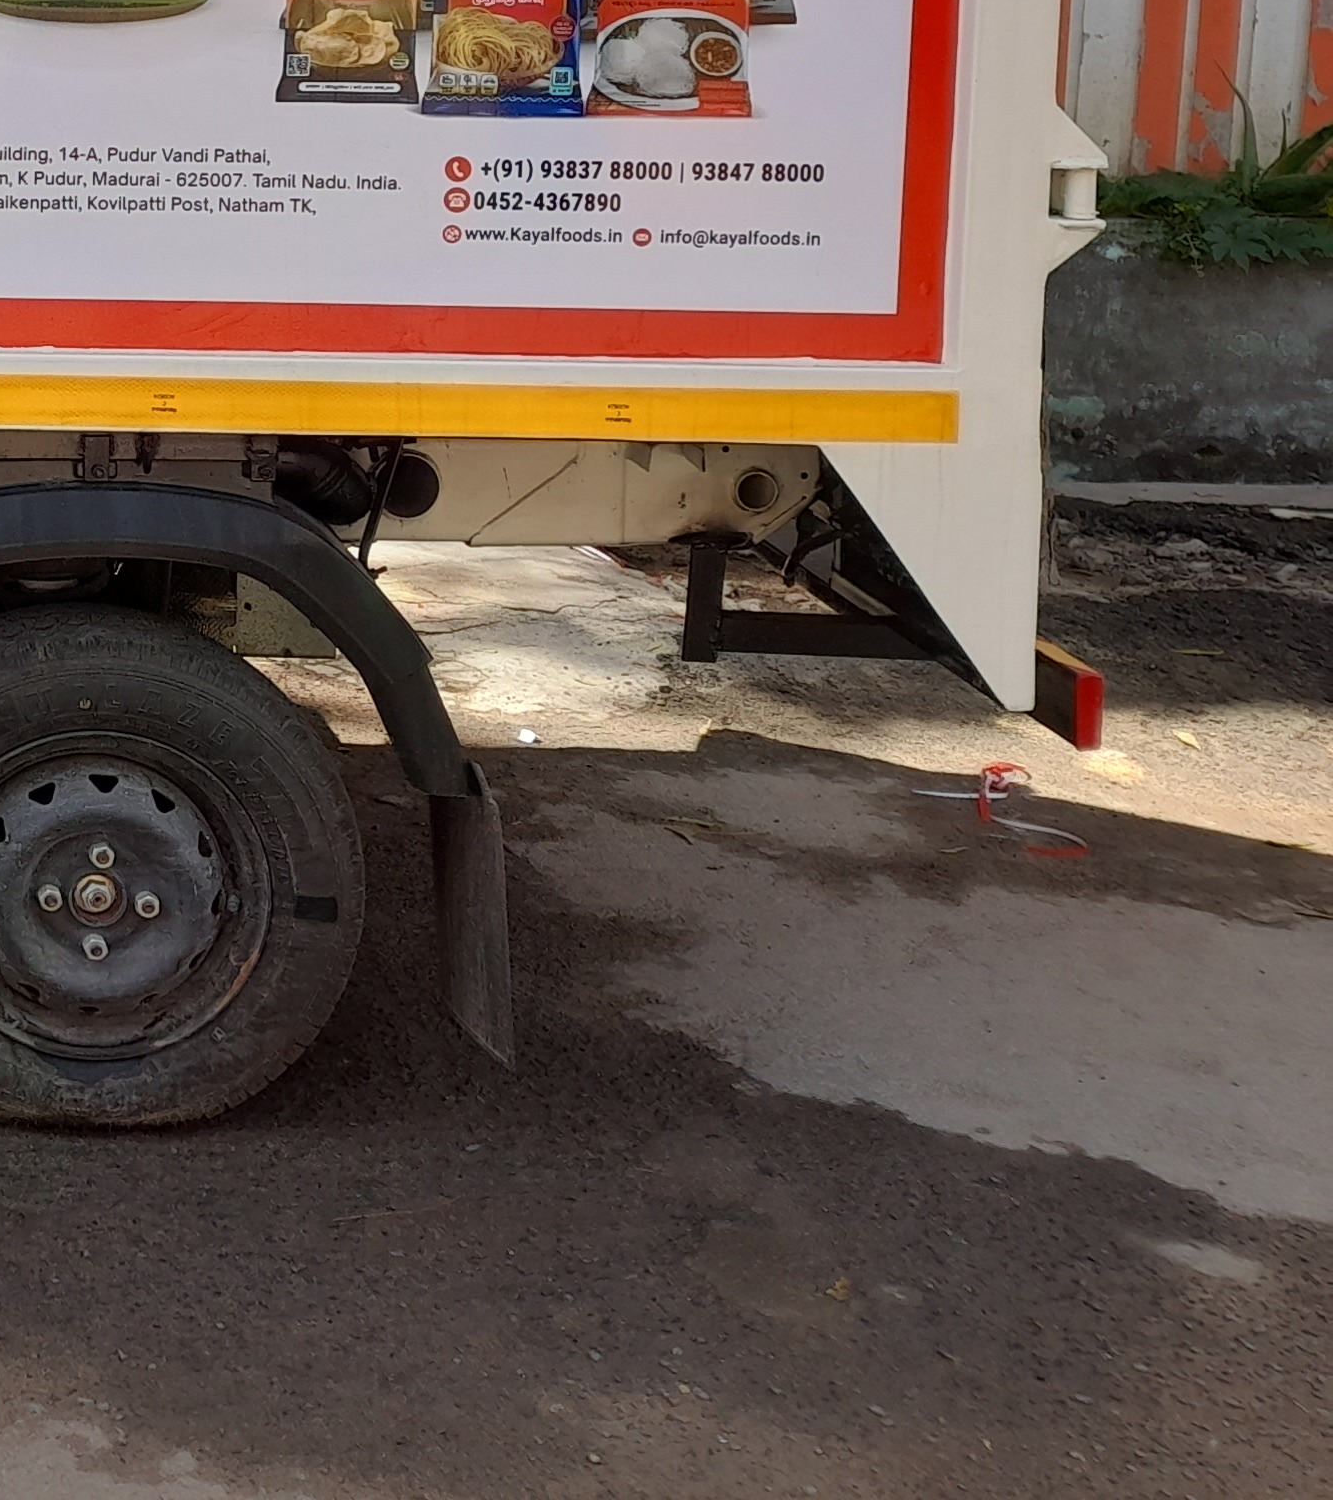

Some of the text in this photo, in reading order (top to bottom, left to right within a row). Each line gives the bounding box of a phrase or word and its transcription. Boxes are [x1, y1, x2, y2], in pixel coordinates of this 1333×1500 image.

[58, 147, 102, 164] 14-A,
[107, 147, 157, 163] Pudur
[161, 147, 209, 163] Vandi
[213, 148, 271, 166] Pathai,
[17, 171, 29, 186] K
[33, 171, 87, 189] Pudur,
[91, 171, 161, 187] Madurai
[176, 172, 247, 189] 625007.
[252, 172, 297, 189] Tamil
[301, 173, 351, 190] Nadu.
[355, 174, 403, 191] India.
[480, 159, 534, 183] +(91)
[540, 160, 603, 180] 93837
[609, 161, 673, 181] 88000
[691, 162, 755, 182] 93847
[761, 163, 825, 182] 88000
[87, 195, 166, 214] Kovilpatti
[171, 197, 213, 215] Post,
[218, 198, 285, 214] Natham
[289, 199, 318, 216] TK,
[473, 191, 622, 212] 0452-4367890
[465, 226, 821, 248] www.Kayalfoods.in info@kayalfoods.in
